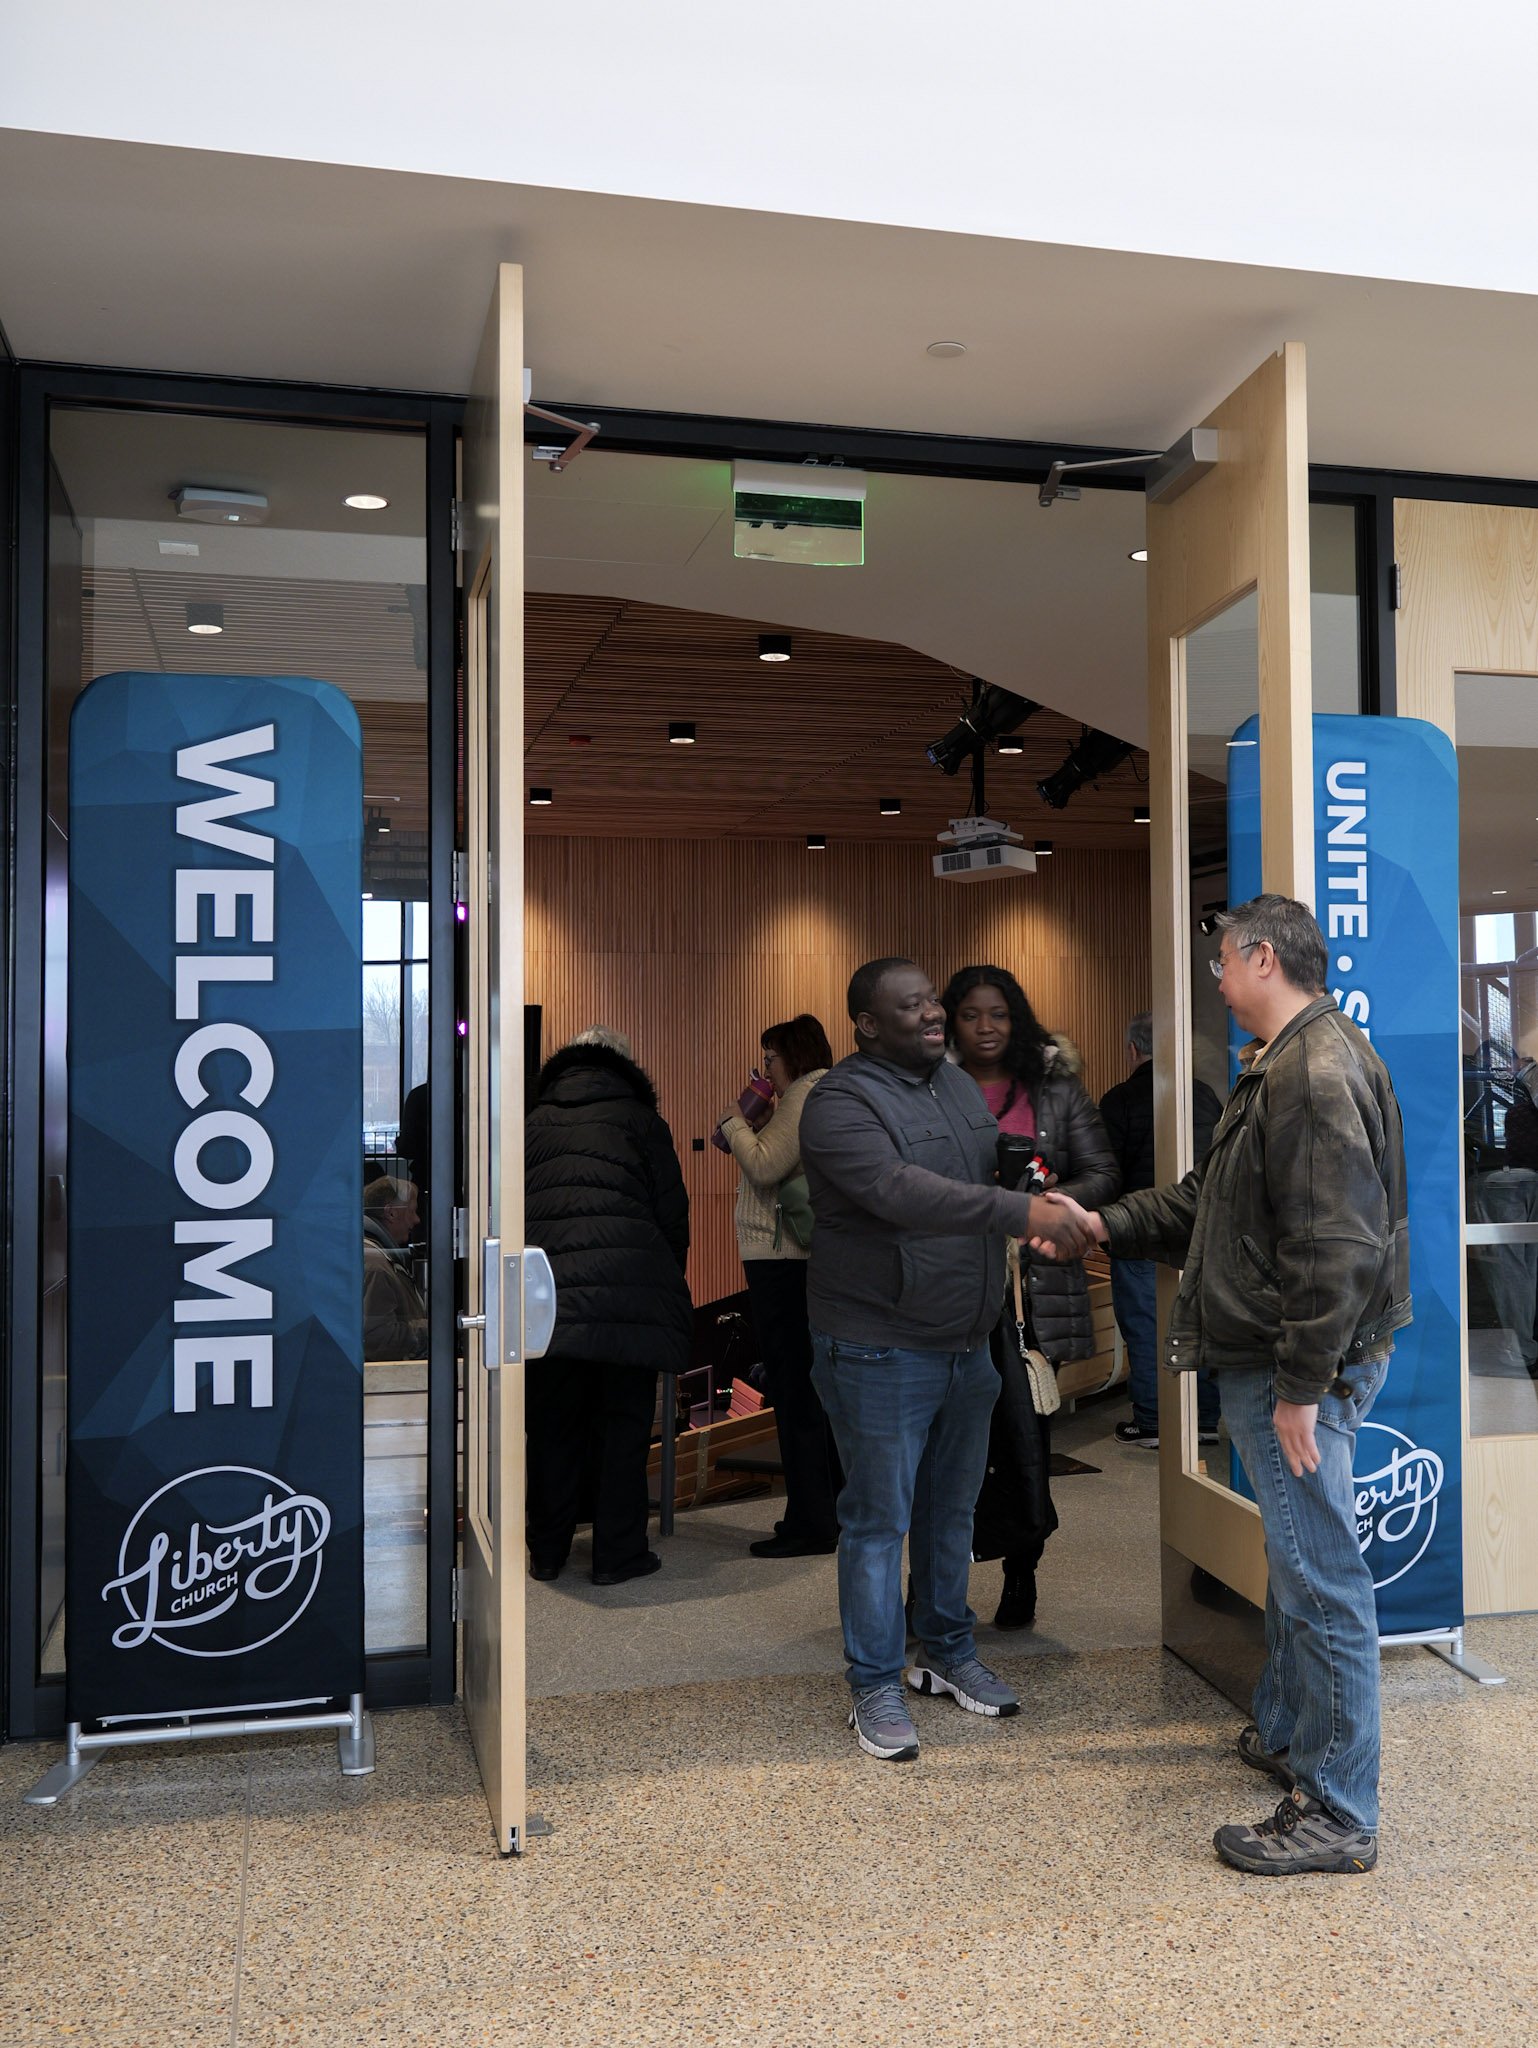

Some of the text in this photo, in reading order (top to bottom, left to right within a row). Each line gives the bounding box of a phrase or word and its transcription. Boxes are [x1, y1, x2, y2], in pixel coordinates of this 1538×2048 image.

[1325, 761, 1369, 939] UNITE
[174, 723, 275, 1413] WELCOME
[101, 1493, 331, 1649] Liberty
[1353, 1447, 1444, 1542] erty
[170, 1571, 239, 1614] CHURCH
